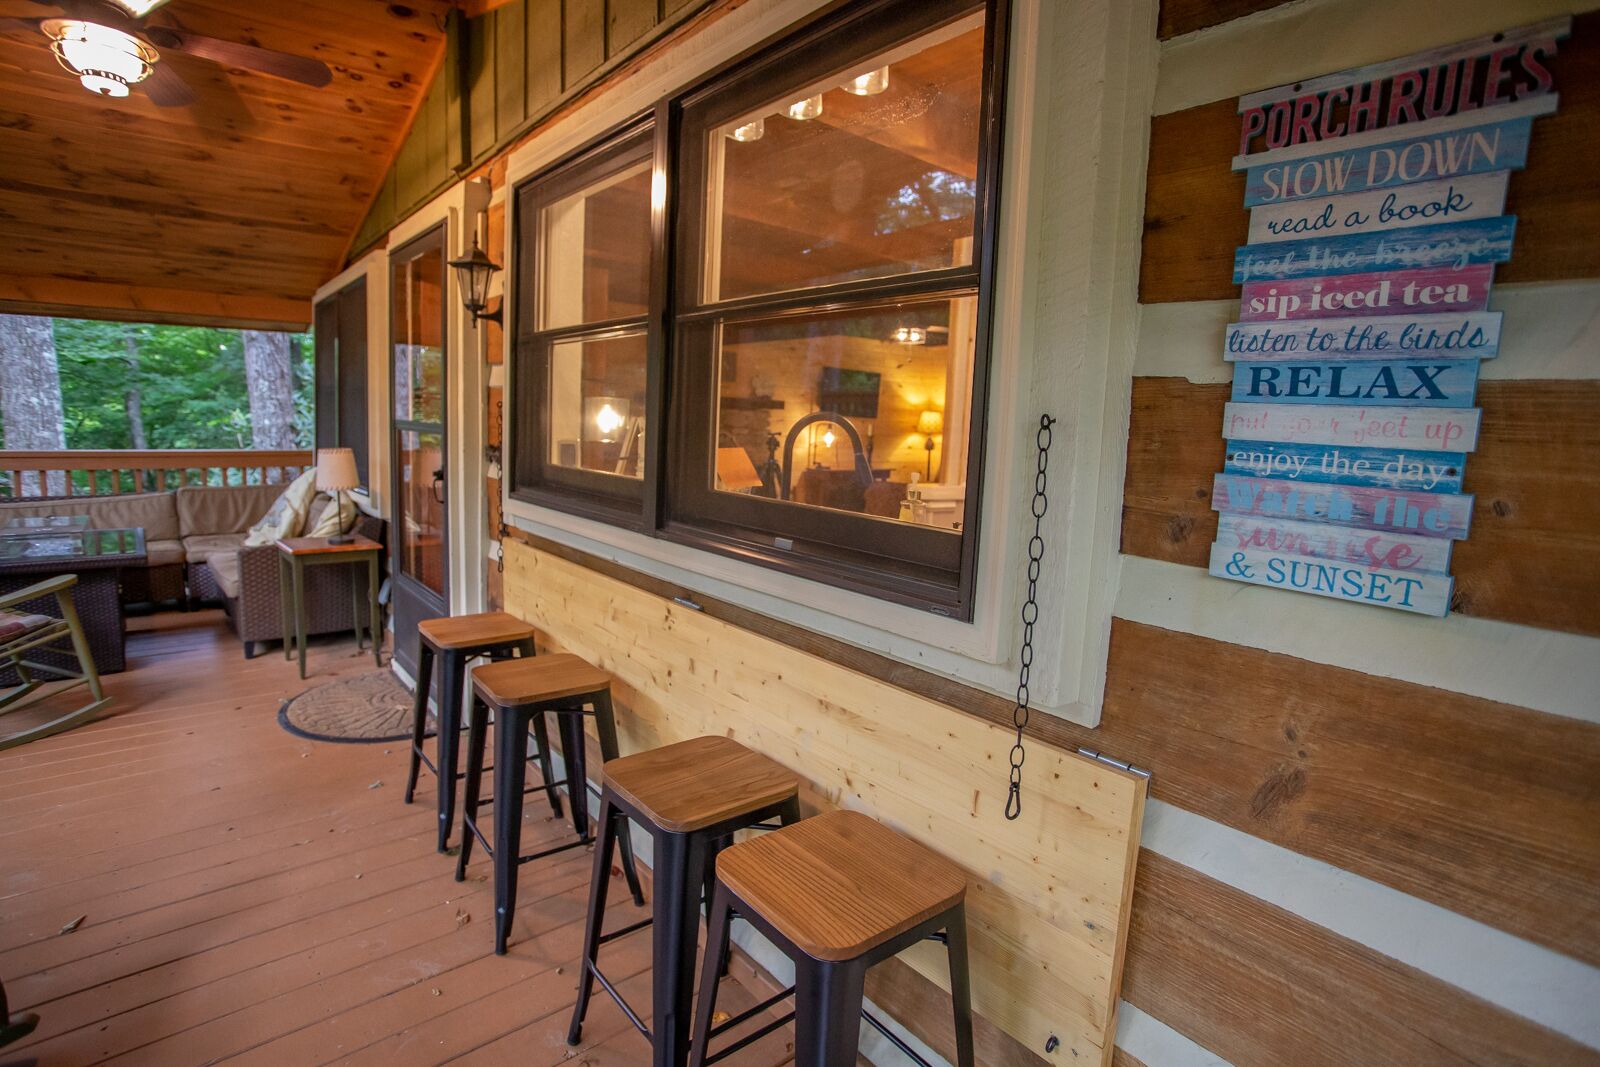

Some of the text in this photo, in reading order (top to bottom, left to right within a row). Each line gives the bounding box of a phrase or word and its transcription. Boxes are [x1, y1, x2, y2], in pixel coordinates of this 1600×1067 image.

[1239, 38, 1557, 156] PORCH RULES
[1261, 128, 1500, 202] SLOW DOWN
[1267, 186, 1473, 235] read a book
[1239, 236, 1493, 281] feel the breeze
[1249, 280, 1470, 320] sip iced tea
[1228, 320, 1490, 353] listen to the birds
[1246, 365, 1452, 399] RELAX
[1282, 415, 1340, 440] yor
[1353, 410, 1409, 444] feet
[1424, 420, 1464, 449] up
[1232, 446, 1450, 490] enjoy the day
[1226, 480, 1450, 532] Watch the
[1225, 552, 1425, 608] & SUNSET
